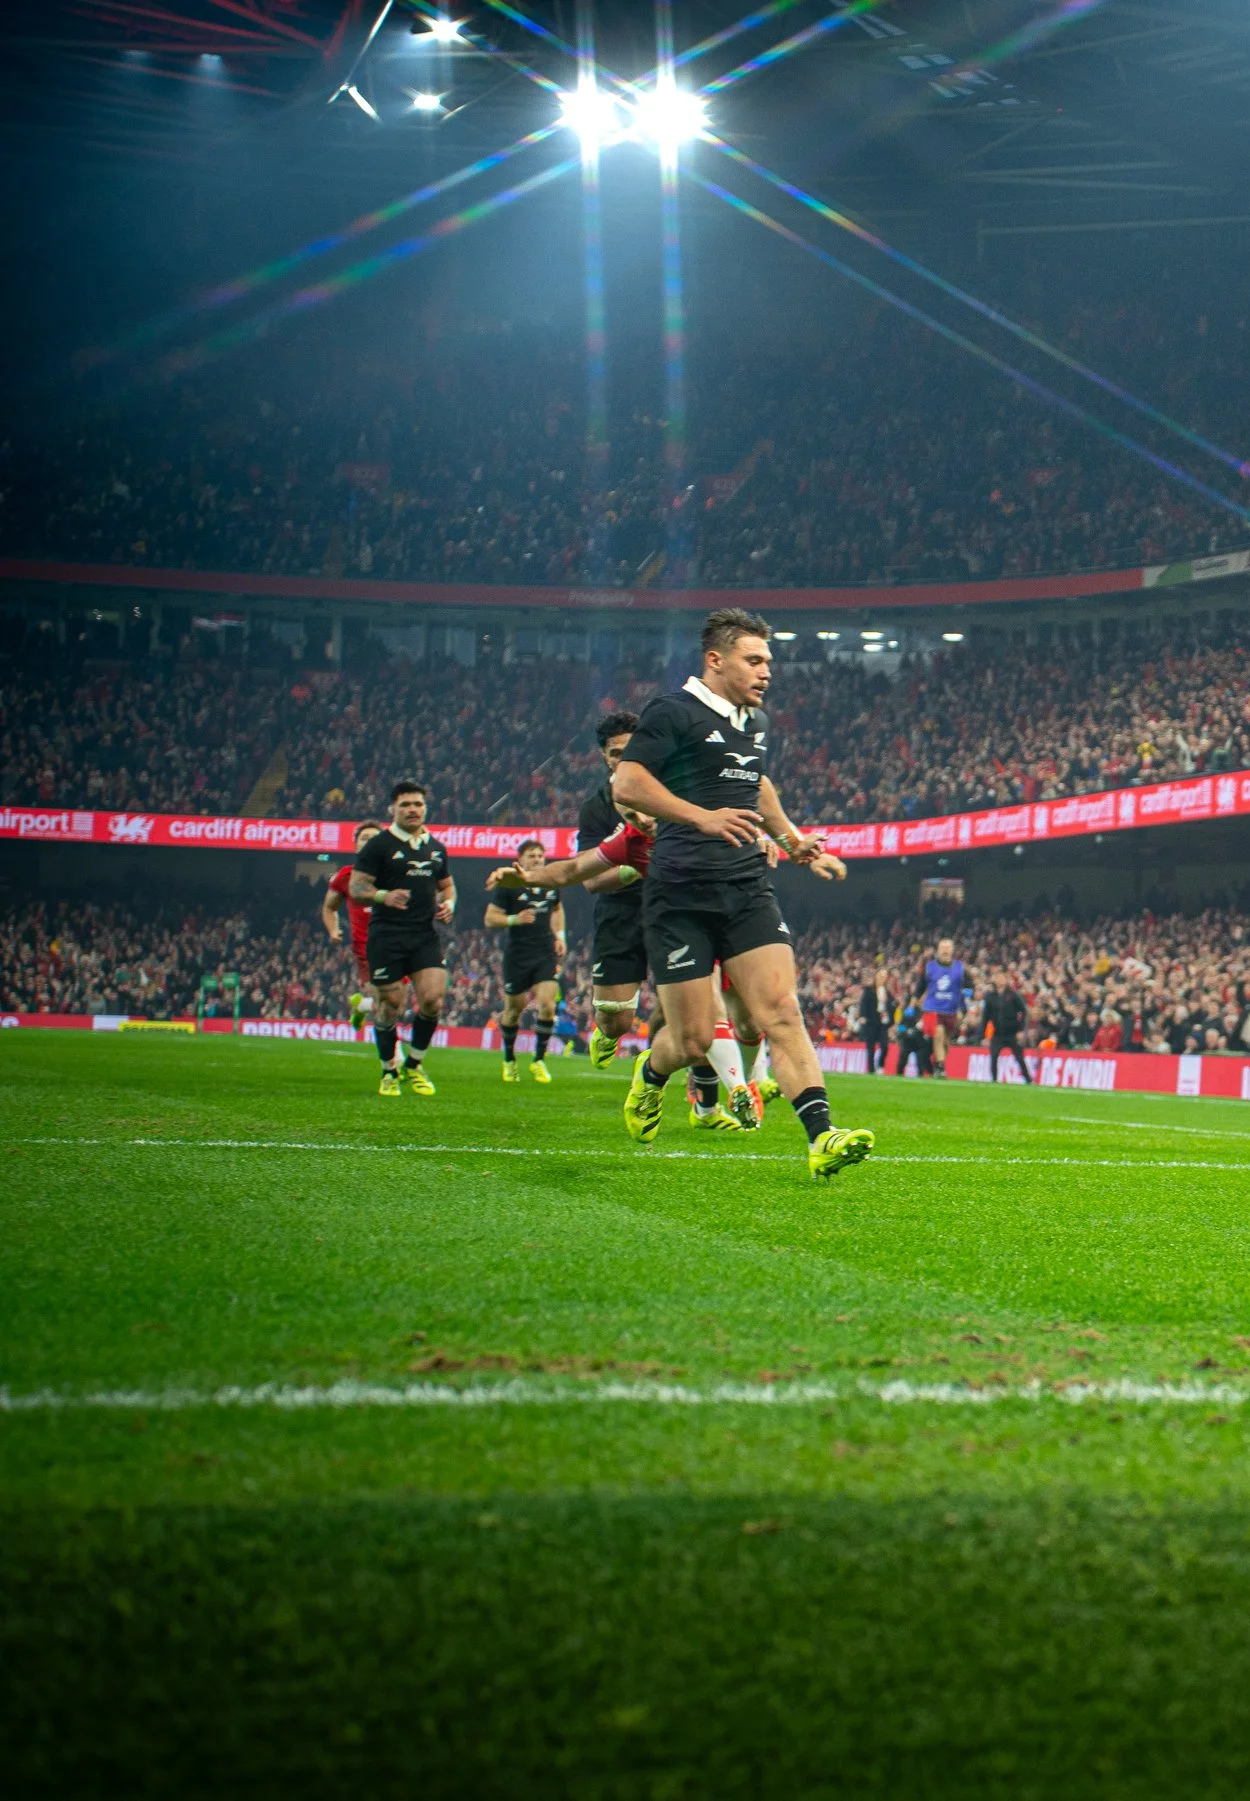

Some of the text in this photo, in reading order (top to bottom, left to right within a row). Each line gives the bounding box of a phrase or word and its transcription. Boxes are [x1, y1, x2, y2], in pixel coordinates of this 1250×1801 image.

[0, 808, 69, 836] irport
[169, 818, 317, 847] cardiff airport
[432, 827, 473, 848] rdiff
